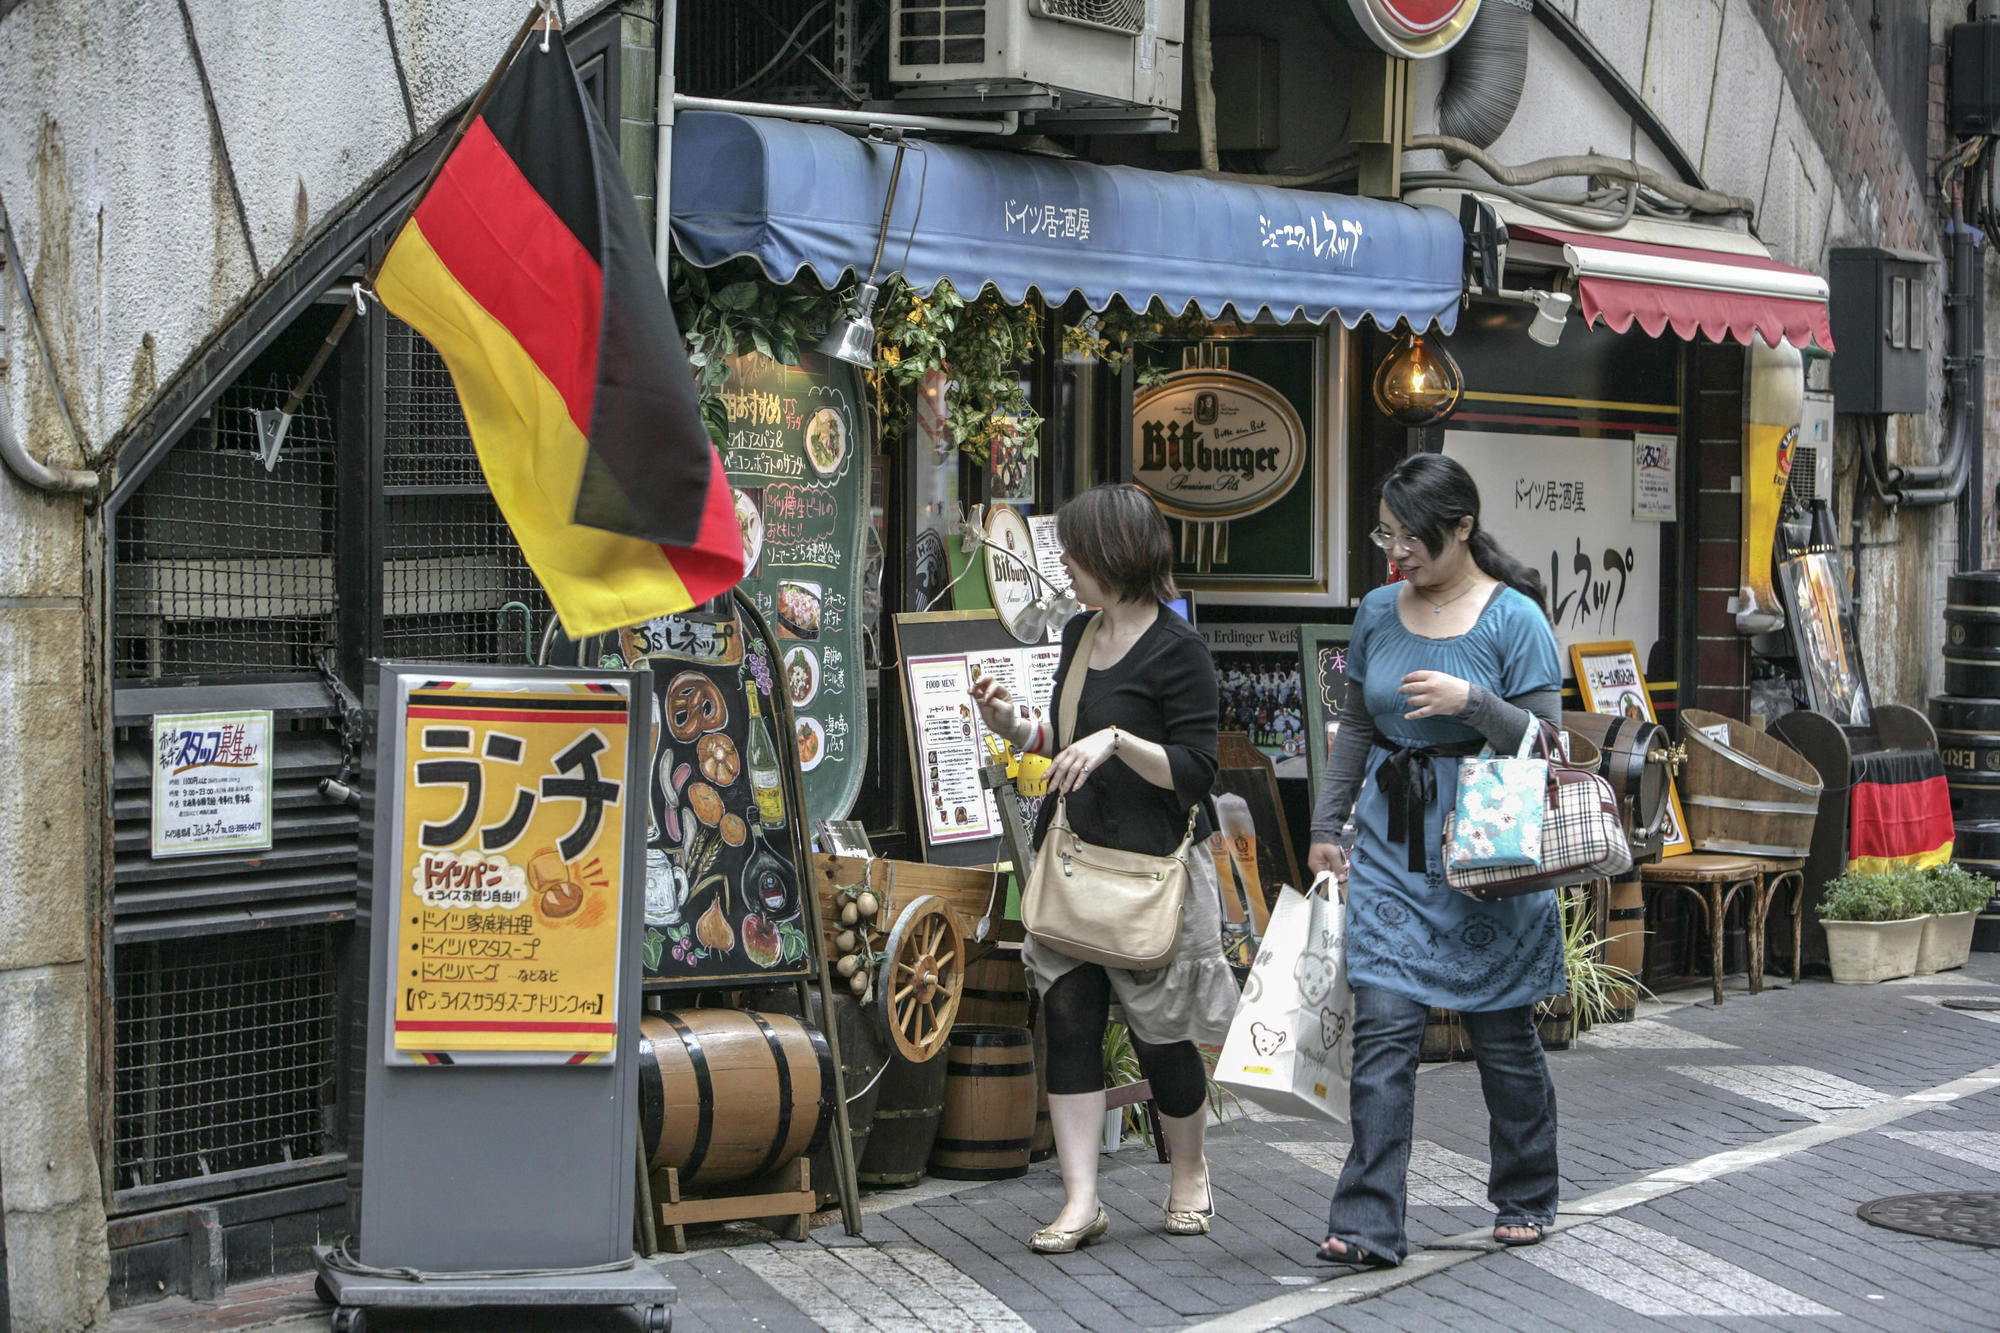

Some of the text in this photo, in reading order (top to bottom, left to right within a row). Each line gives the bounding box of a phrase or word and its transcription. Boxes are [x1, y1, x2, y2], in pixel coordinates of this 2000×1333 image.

[1004, 199, 1091, 241] ドイツ居酒屋
[726, 429, 784, 449] ワイトアスパラ&
[1139, 419, 1280, 482] Bitburger
[1166, 474, 1241, 491] Premium Pils
[1515, 478, 1586, 513] ドイツ居酒屋
[1551, 536, 1634, 637] レネップ
[1214, 628, 1265, 648] Erdinger
[925, 678, 956, 689] FOOD MENU
[414, 727, 622, 864] ランチ
[424, 857, 503, 890] ドイツパン
[421, 910, 534, 936] ドイツ家庭料理
[421, 936, 542, 960] ドイツパスタスープ
[421, 961, 500, 982] ドイツバーグ
